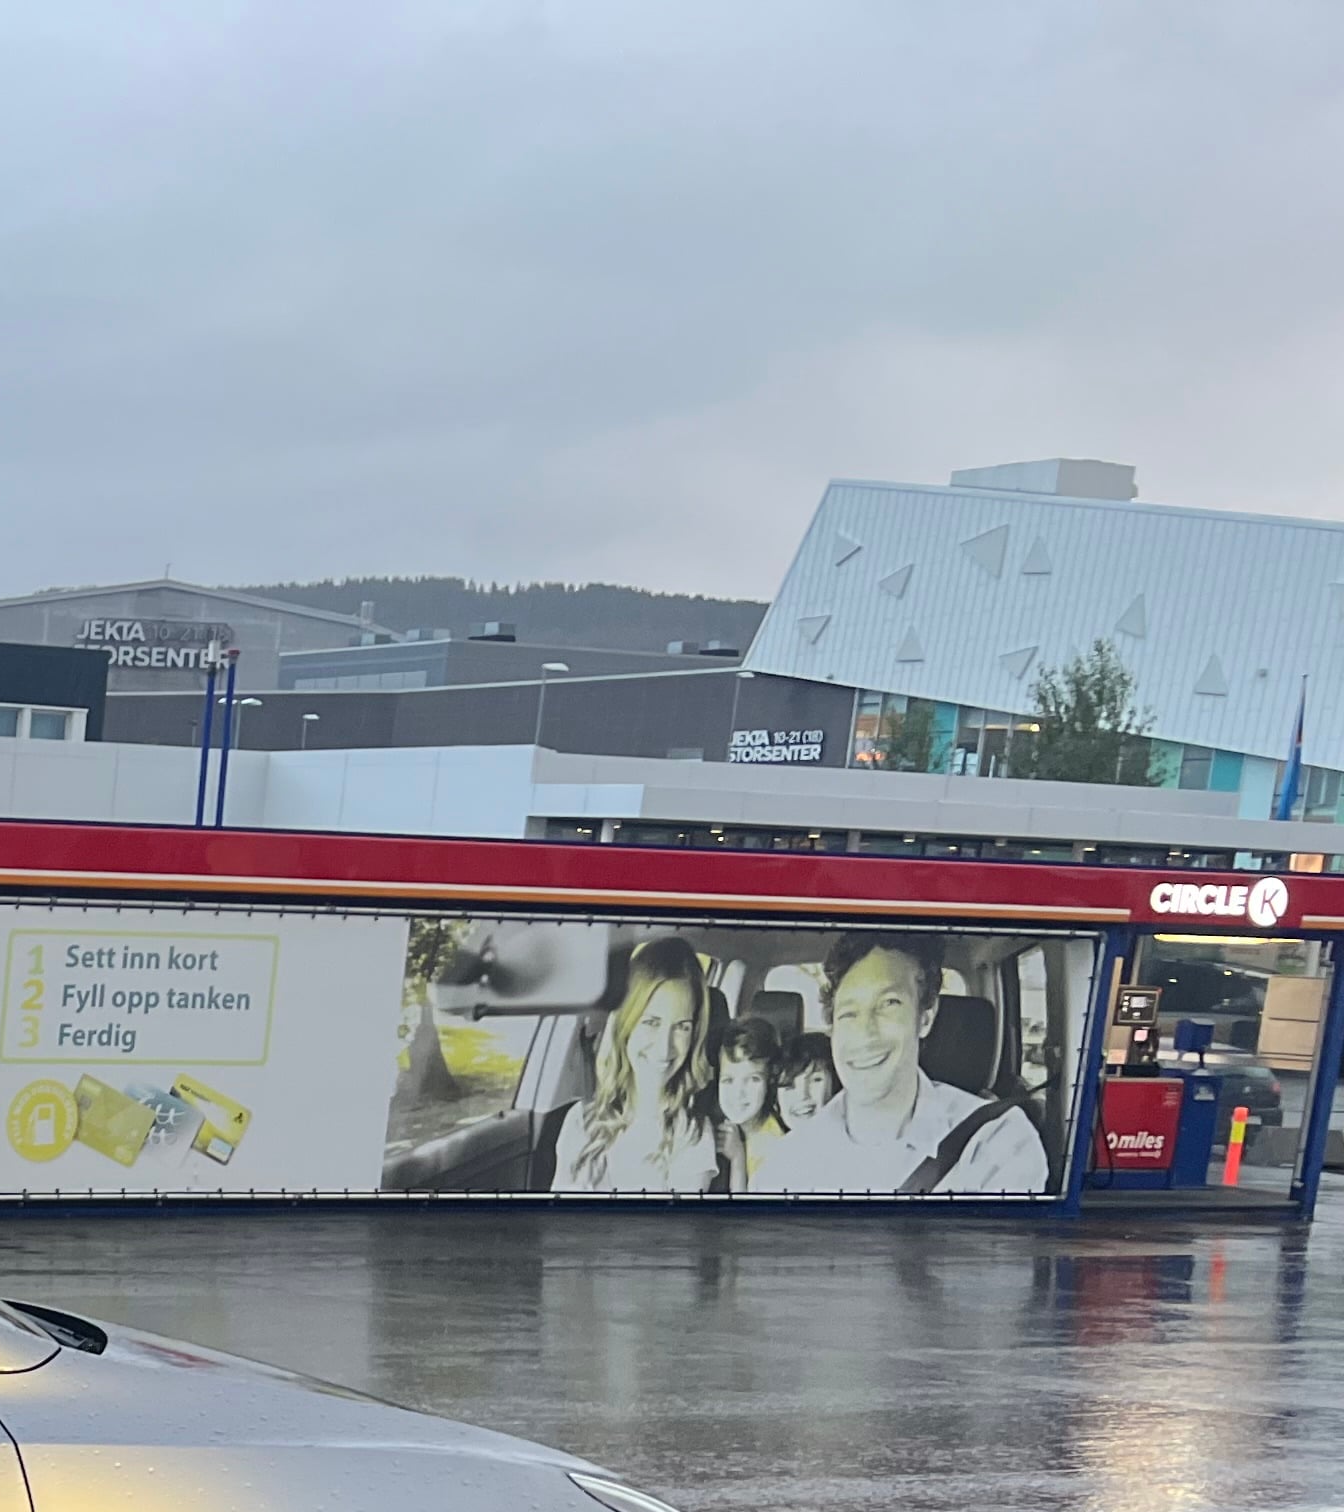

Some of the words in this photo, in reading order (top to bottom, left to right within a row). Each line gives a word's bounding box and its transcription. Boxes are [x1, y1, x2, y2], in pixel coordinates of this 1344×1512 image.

[76, 619, 146, 641] JEKTA
[74, 643, 229, 668] ORSENTER
[728, 730, 770, 746] JEKTA
[728, 744, 822, 763] STORSENTER
[1149, 882, 1249, 916] CIRCLE
[1248, 876, 1289, 927] K
[27, 944, 45, 975] 1
[65, 945, 116, 969] Sett
[121, 946, 160, 970] inn
[167, 946, 219, 971] kort
[20, 978, 45, 1011] 2
[62, 983, 105, 1013] Fyll
[111, 990, 160, 1014] opp
[166, 986, 251, 1011] tanken
[18, 1015, 41, 1048] 3
[57, 1023, 137, 1053] Ferdig
[1117, 1131, 1165, 1149] miles
